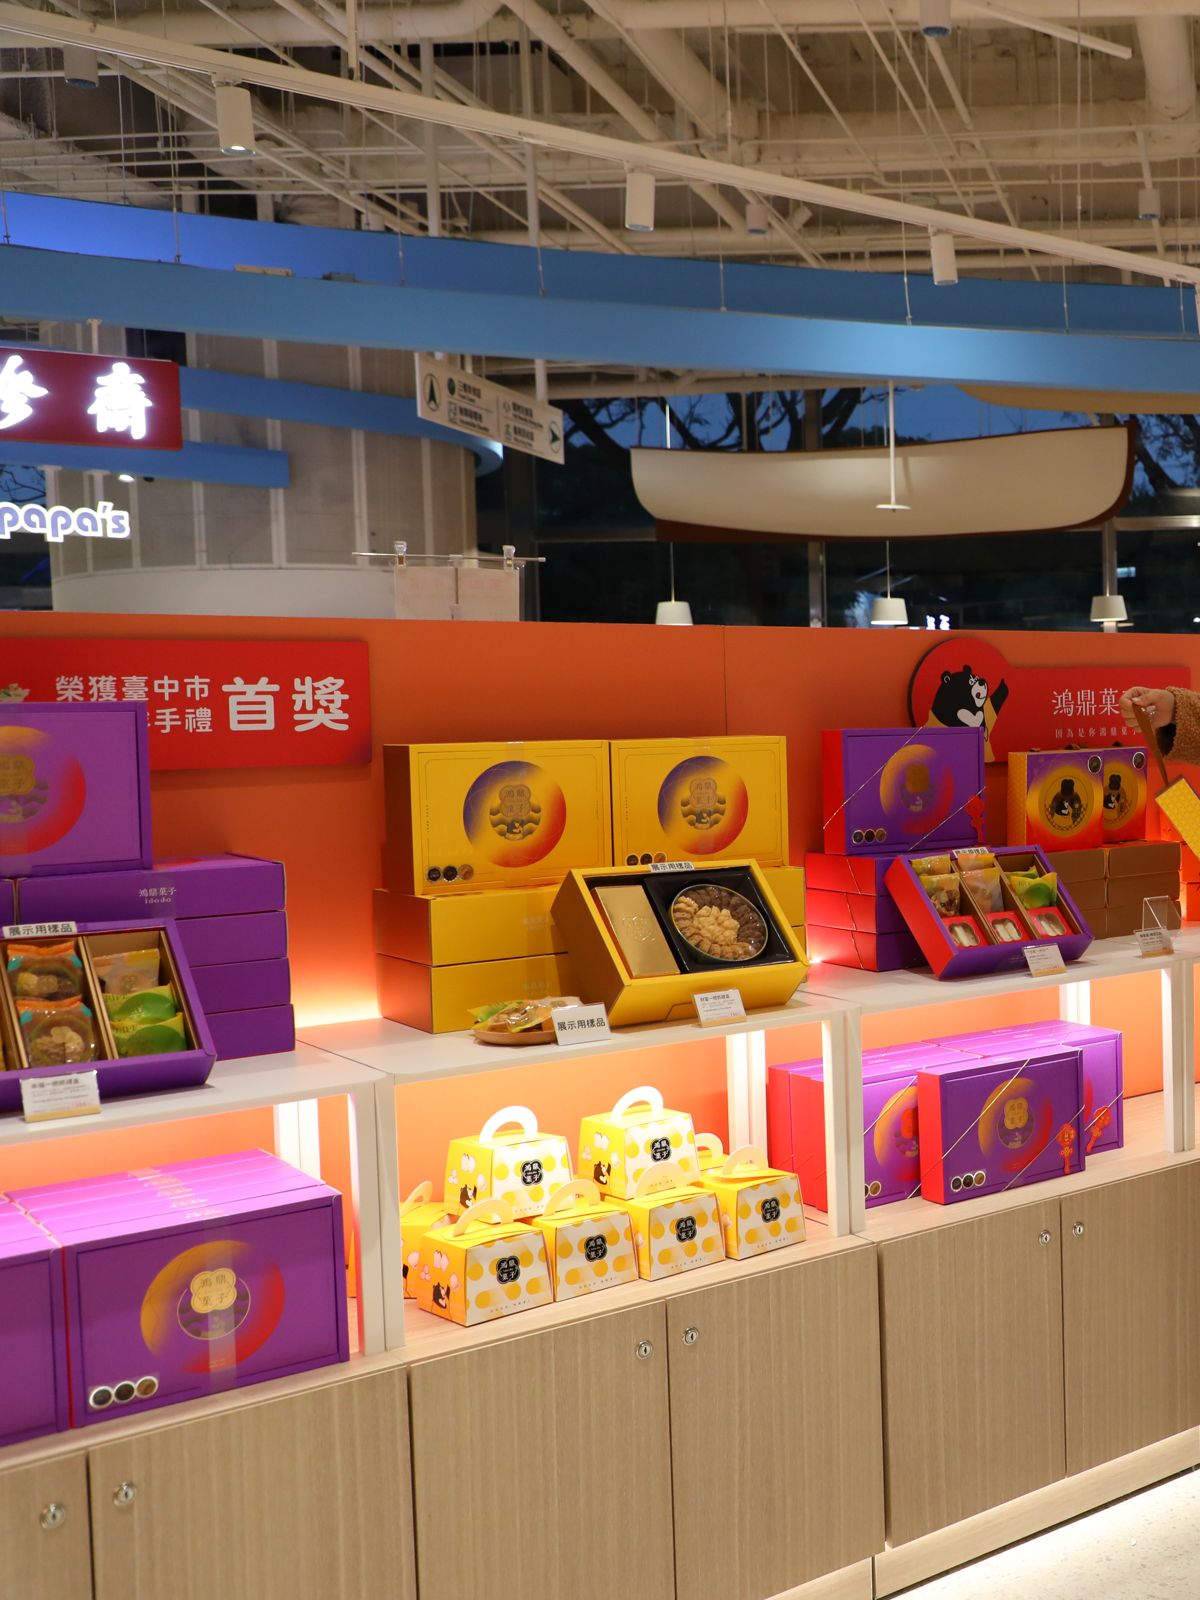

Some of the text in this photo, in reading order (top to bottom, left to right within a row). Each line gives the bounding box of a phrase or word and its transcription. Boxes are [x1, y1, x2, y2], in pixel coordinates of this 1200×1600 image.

[56, 675, 211, 702] 榮獲臺中市
[222, 676, 349, 732] 首獎
[1052, 688, 1128, 717] 鴻鼎菓
[148, 707, 213, 733] 手禮
[9, 924, 73, 936] 展示用樣品
[557, 1018, 606, 1031] 展示用樣品
